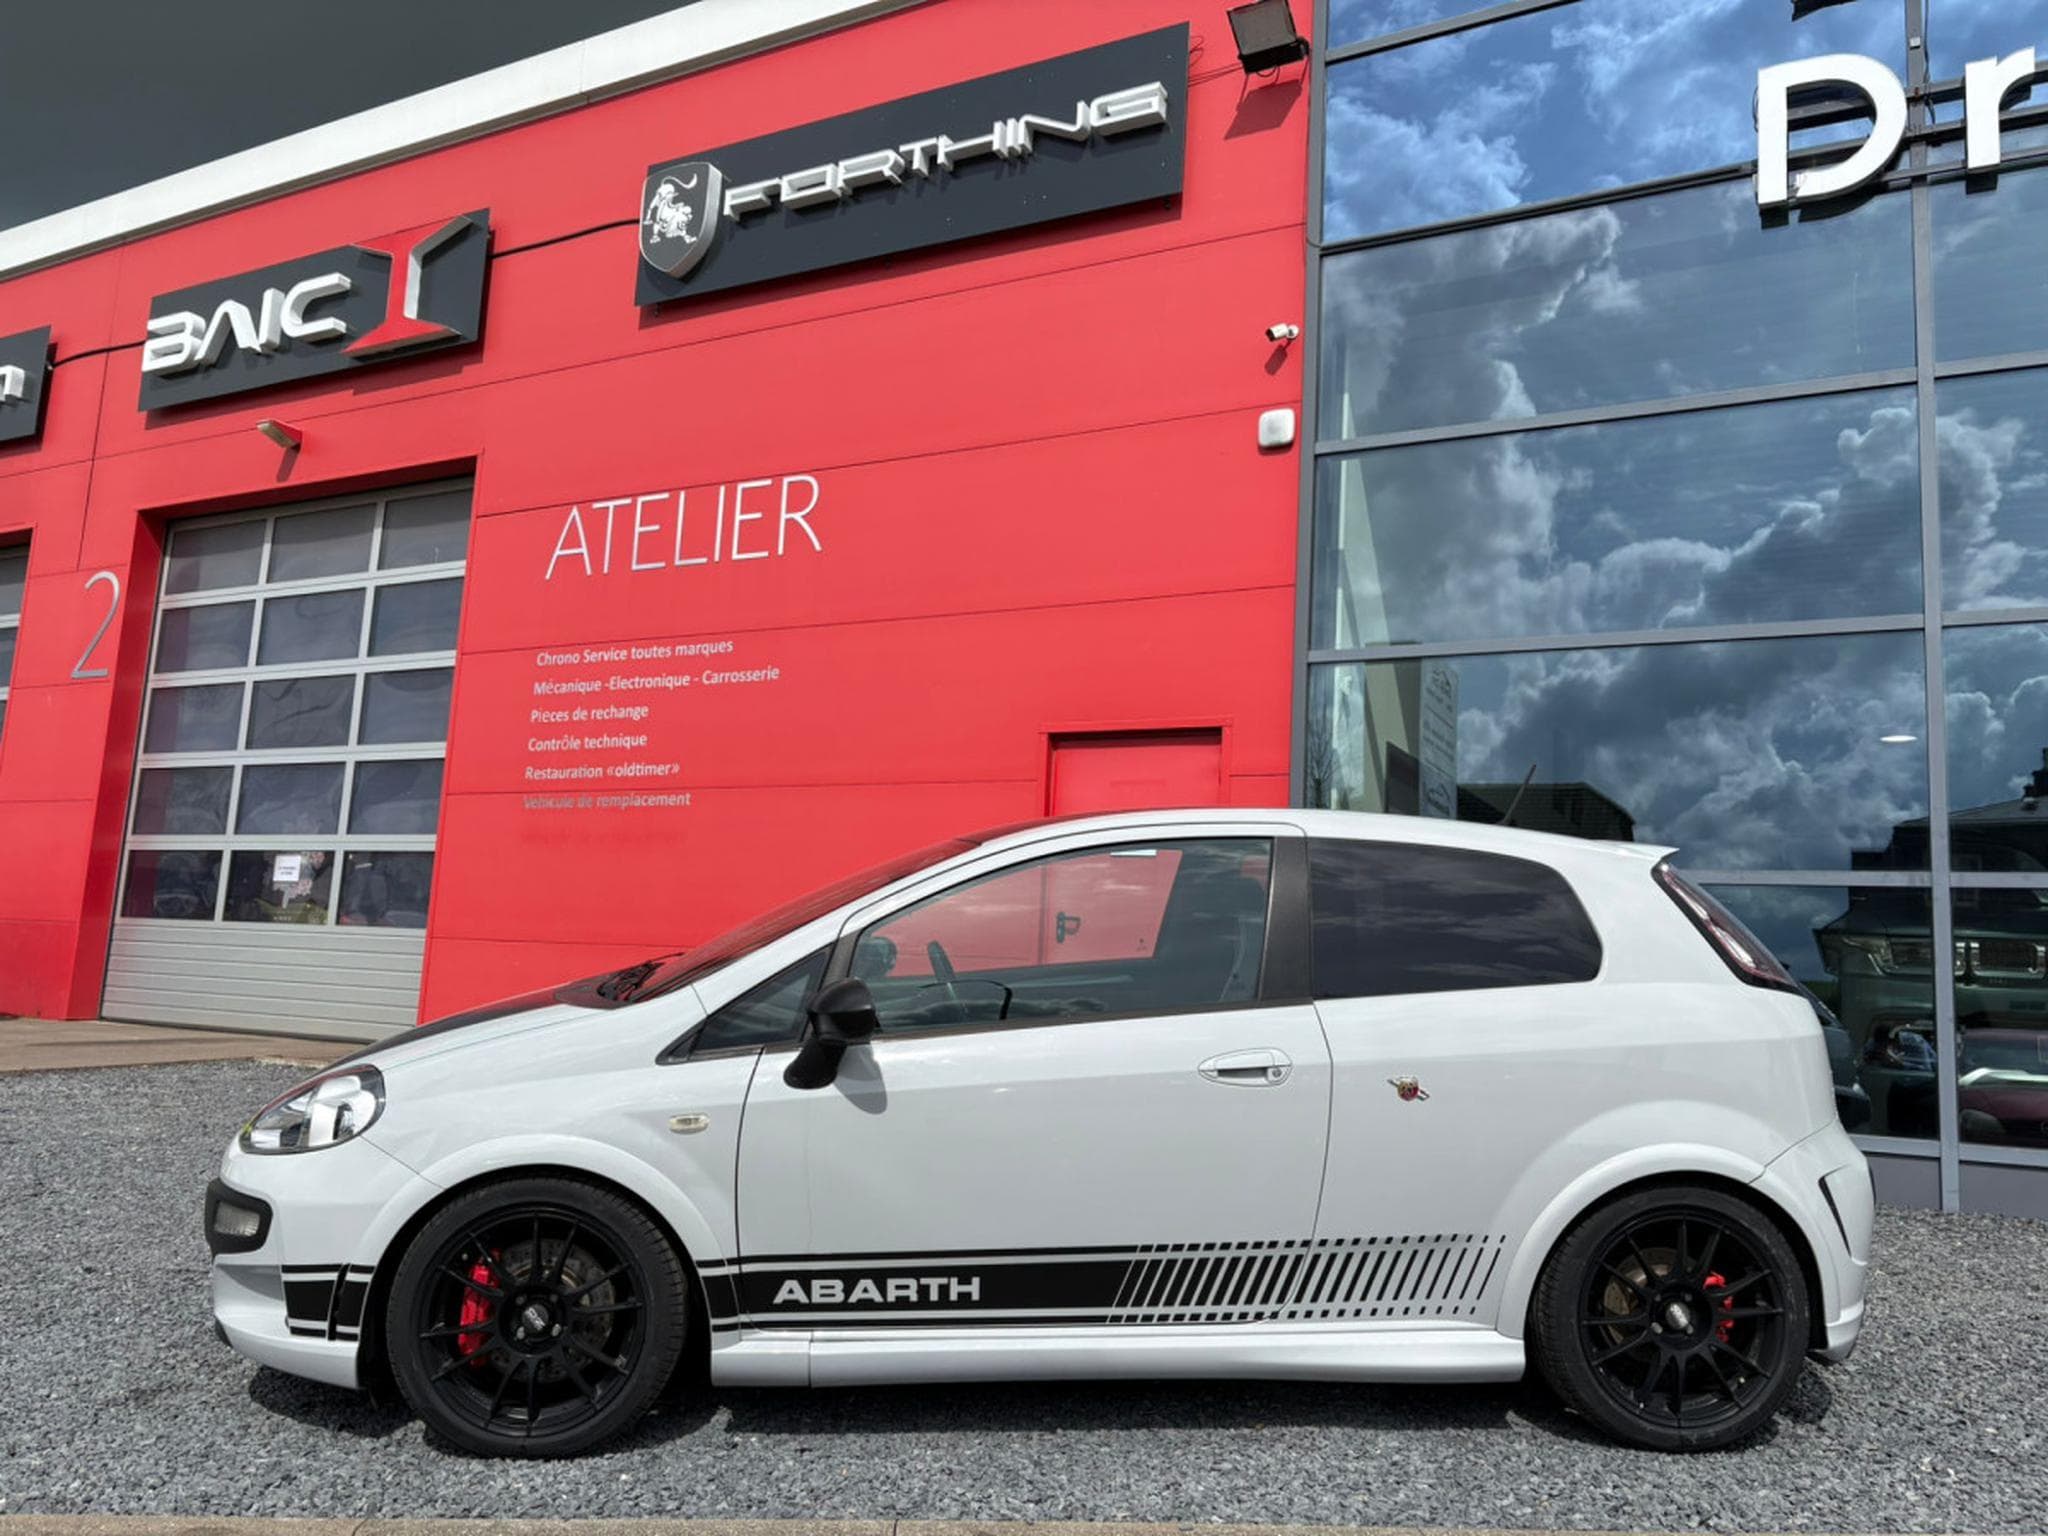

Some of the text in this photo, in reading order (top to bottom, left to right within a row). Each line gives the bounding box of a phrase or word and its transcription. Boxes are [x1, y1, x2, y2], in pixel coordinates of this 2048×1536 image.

[723, 81, 1168, 223] FORTHING
[141, 271, 352, 378] BAIC
[545, 473, 823, 580] ATELIER
[70, 570, 121, 680] 2
[536, 640, 734, 666] Chrono Service toutes marques
[533, 678, 602, 695] Mécanique
[702, 665, 780, 685] Carrosserie
[572, 706, 589, 721] de
[591, 704, 649, 721] rechange
[528, 732, 648, 752] Contrôle technique
[524, 763, 604, 780] Restauration
[578, 794, 593, 809] de
[596, 791, 692, 811] remplacement
[773, 1276, 982, 1305] ABARTH
